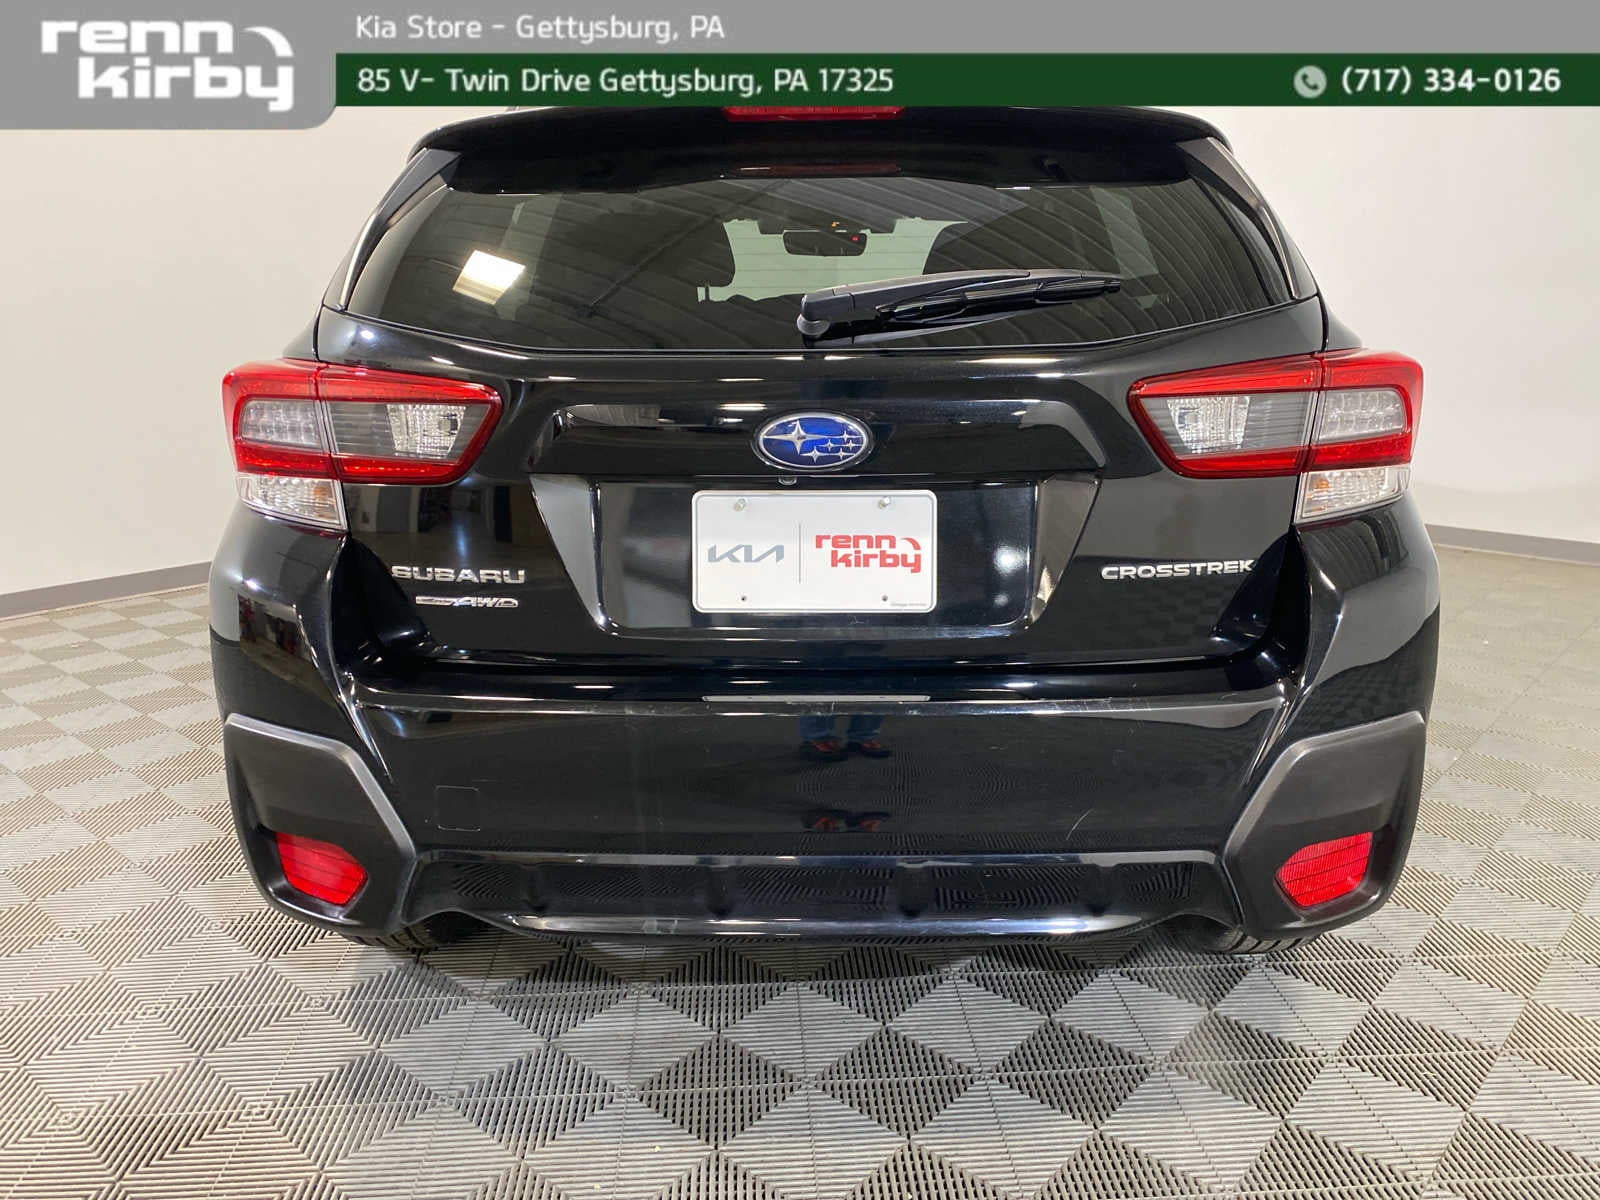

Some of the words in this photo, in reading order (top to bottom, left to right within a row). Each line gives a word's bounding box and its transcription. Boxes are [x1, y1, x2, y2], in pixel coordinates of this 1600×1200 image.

[815, 534, 896, 549] renn
[830, 550, 922, 574] kirby
[1101, 559, 1257, 580] CROSSTREK
[391, 565, 526, 584] SUBARU
[453, 596, 519, 608] AWD
